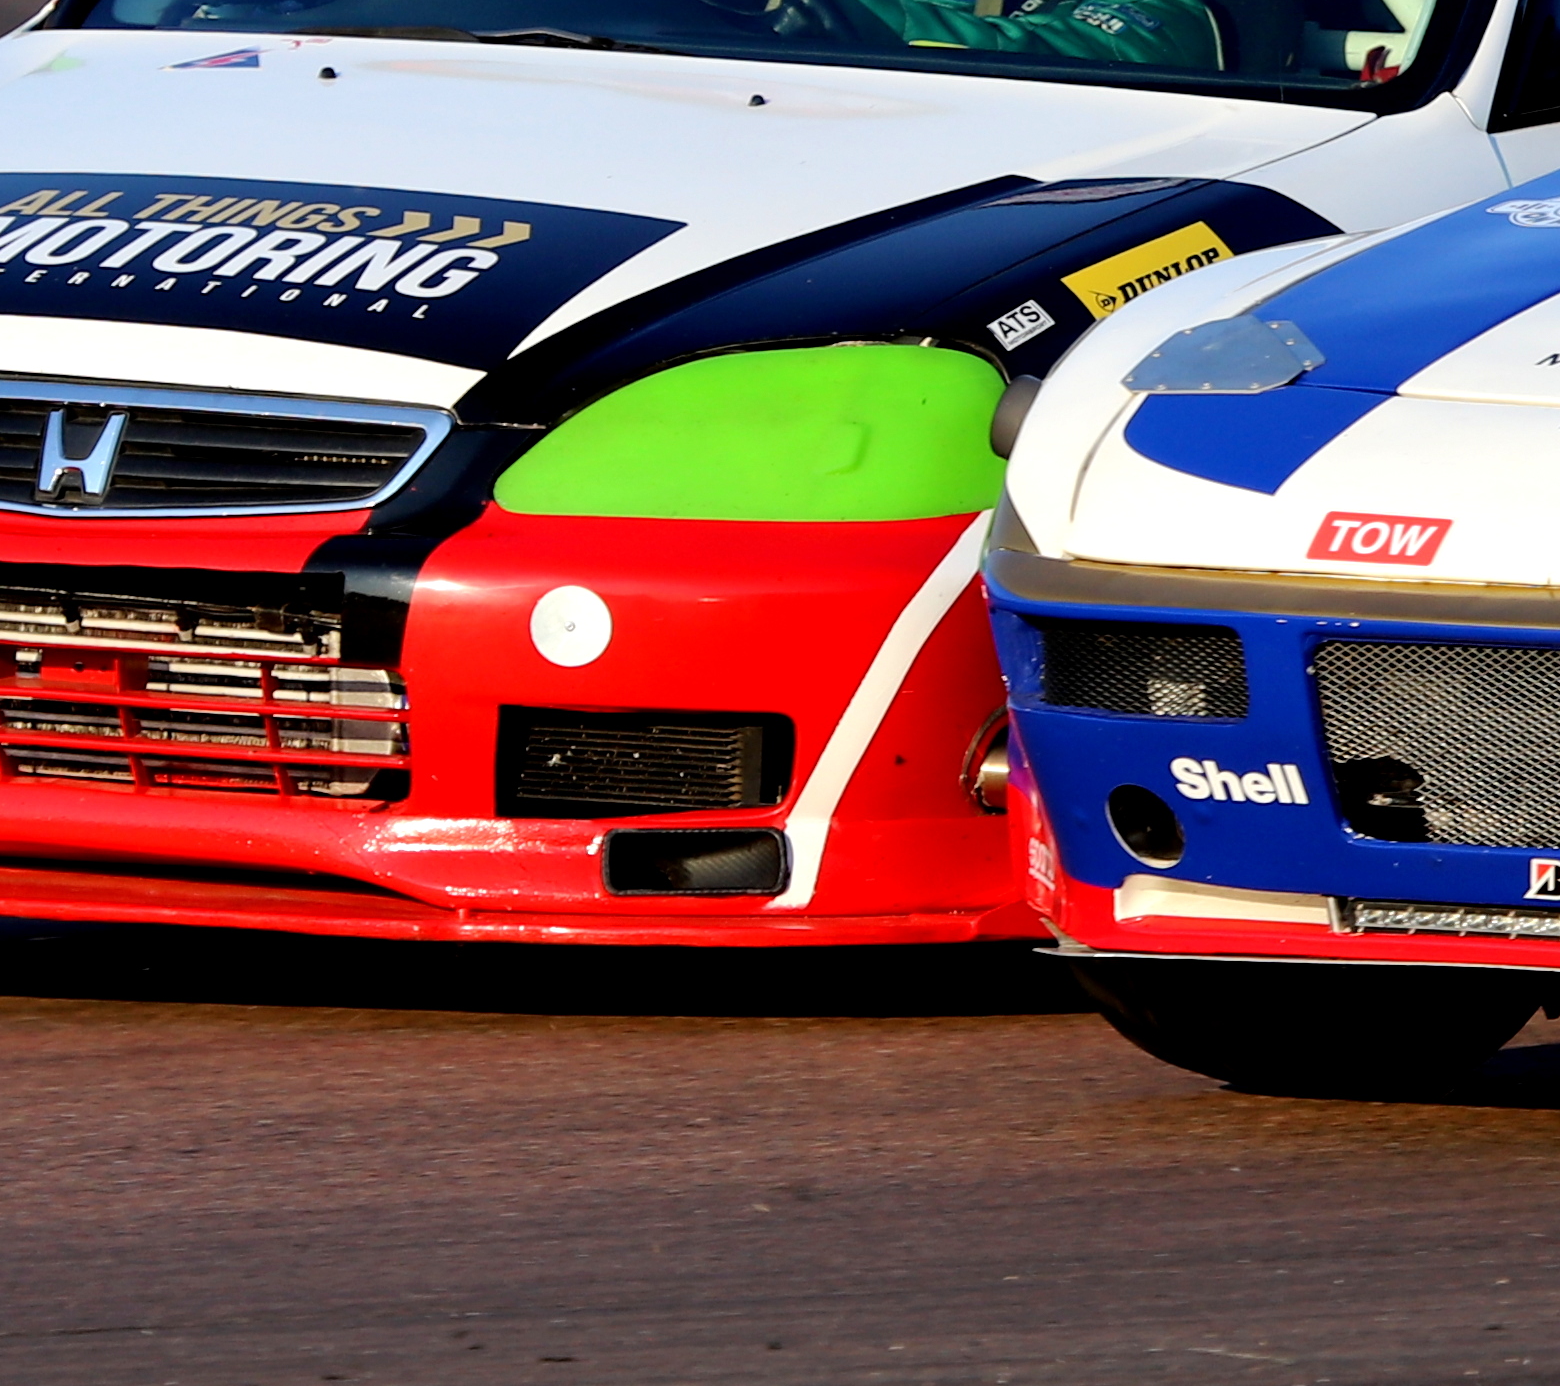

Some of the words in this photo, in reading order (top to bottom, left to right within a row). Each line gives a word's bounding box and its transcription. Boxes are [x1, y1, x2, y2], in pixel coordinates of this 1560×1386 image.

[132, 193, 382, 233] THINGS
[1116, 246, 1221, 305] DUNLOP
[996, 305, 1042, 340] ATS
[1328, 519, 1439, 557] TOW
[1170, 756, 1310, 805] Shell
